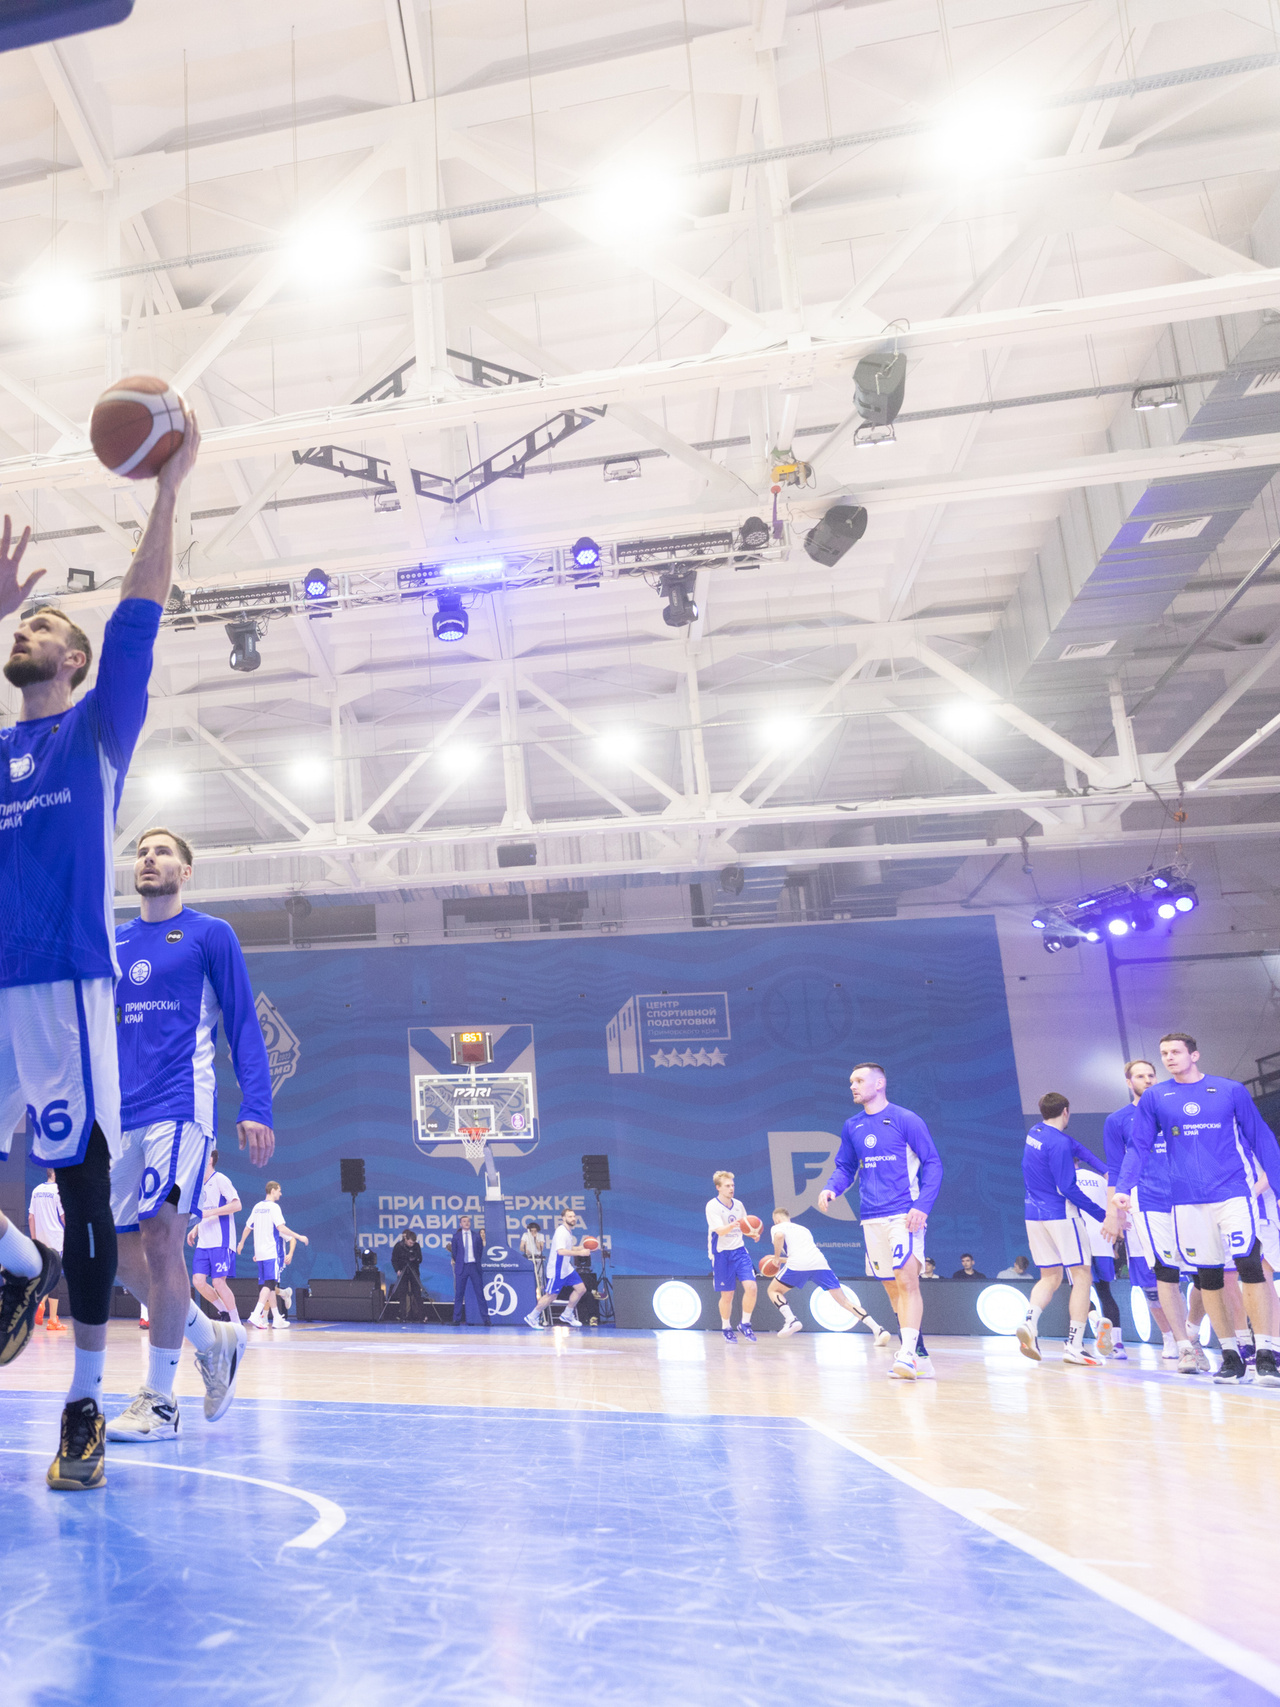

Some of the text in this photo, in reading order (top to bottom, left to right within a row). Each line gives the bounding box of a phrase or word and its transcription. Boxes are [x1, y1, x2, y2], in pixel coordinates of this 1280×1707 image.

[125, 999, 180, 1012] ПРИМОРСКИЙ
[646, 1001, 680, 1010] ЦЕНТР
[124, 1012, 144, 1024] КРАЙ
[646, 1008, 716, 1018] СПОРТИВНОЙ
[647, 1018, 716, 1027] ПОДГОТОВКИ
[453, 1087, 492, 1098] PARI
[1183, 1122, 1222, 1130] ПРИМОРСКИЙ
[378, 1196, 586, 1212] ПРИ ПОДЕРЖКЕ
[215, 1262, 228, 1272] 24
